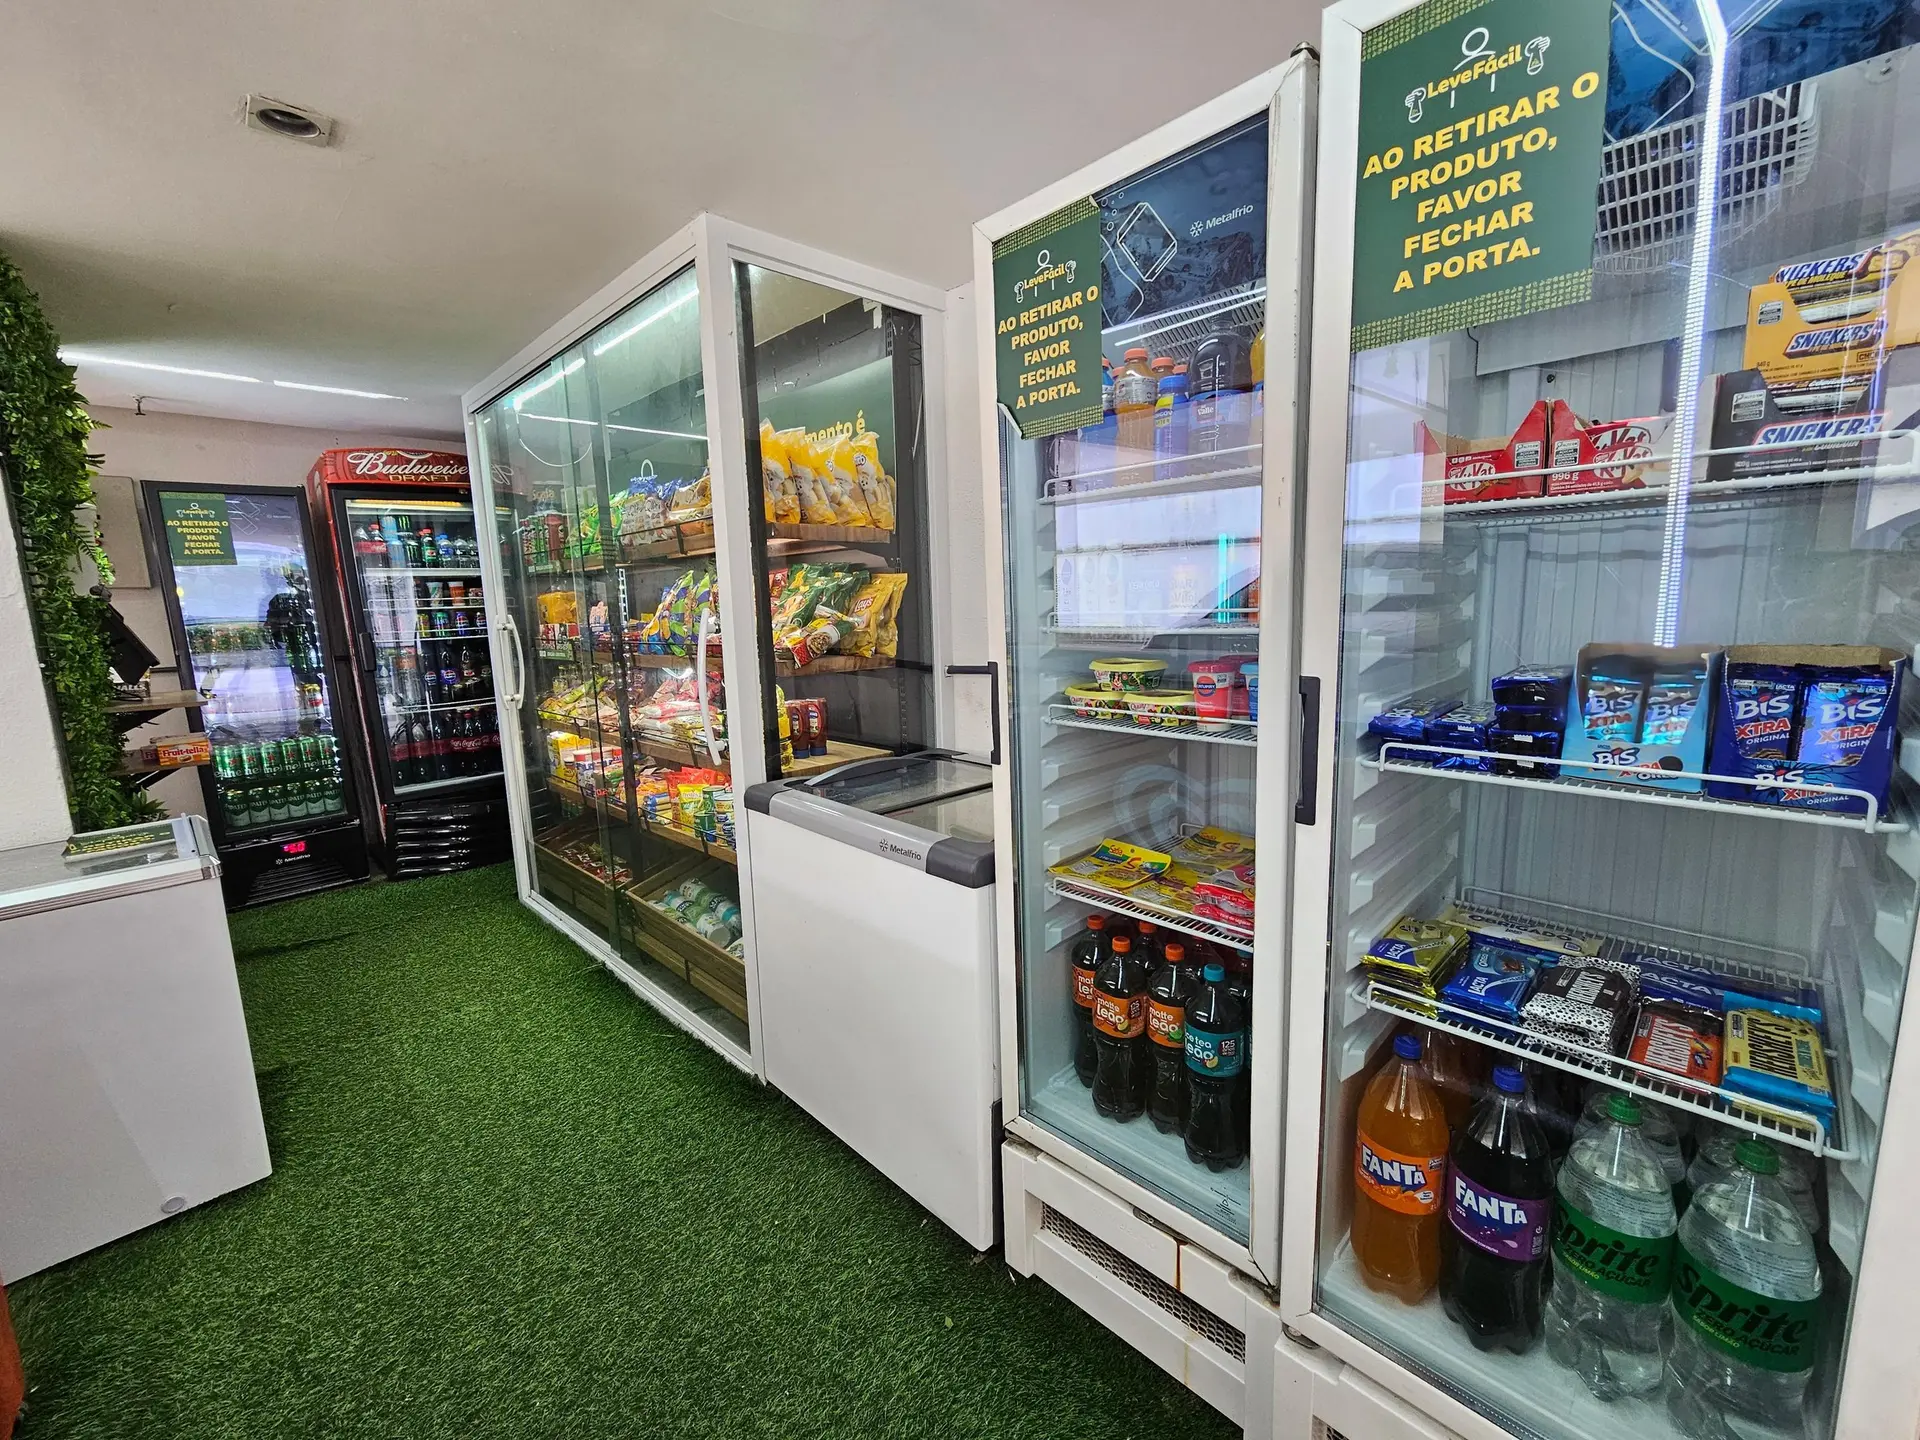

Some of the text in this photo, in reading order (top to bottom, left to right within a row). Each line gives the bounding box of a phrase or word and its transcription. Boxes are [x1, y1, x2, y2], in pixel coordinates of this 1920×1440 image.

[1427, 44, 1522, 98] LeveFácil
[1363, 71, 1600, 179] AO RETIRAR O
[1391, 126, 1557, 200] PRODUTO,
[1417, 170, 1522, 223] FAVOR
[1206, 204, 1254, 229] Metalfrio
[1404, 201, 1534, 258] FECHAR
[1024, 263, 1066, 289] LeveFácil
[1393, 237, 1540, 293] A PORTA.
[998, 285, 1099, 335] AO RETIRAR O
[1011, 315, 1084, 350] PRODUTO,
[1789, 324, 1873, 350] SNICKERS
[1024, 340, 1070, 366] FAVOR
[1019, 359, 1077, 388] FECHAR
[1016, 381, 1080, 409] A PORTA.
[856, 409, 865, 434] é
[1758, 415, 1884, 445] SNICKERS
[347, 451, 470, 475] Budweise
[1552, 472, 1570, 481] 996
[1736, 718, 1790, 739] XTRA
[1746, 733, 1790, 745] ORIGINAL
[1815, 723, 1878, 744] XTRA
[162, 745, 204, 757] Fruit-tella
[1831, 739, 1870, 750] ORIGIN
[1807, 795, 1849, 805] ORIGINAL
[890, 844, 921, 861] Metalfrio
[1469, 914, 1572, 941] OBRIGADO
[1096, 1004, 1124, 1024] leão
[1097, 997, 1120, 1012] matte
[1150, 1006, 1174, 1020] matte
[1150, 1013, 1178, 1033] leão
[1195, 1036, 1211, 1049] tea
[1221, 1040, 1236, 1049] 125
[1362, 1144, 1426, 1187] FANTA
[1455, 1176, 1528, 1225] FANTA
[1676, 1262, 1808, 1344] Sprite
[1695, 1308, 1735, 1337] ZERO
